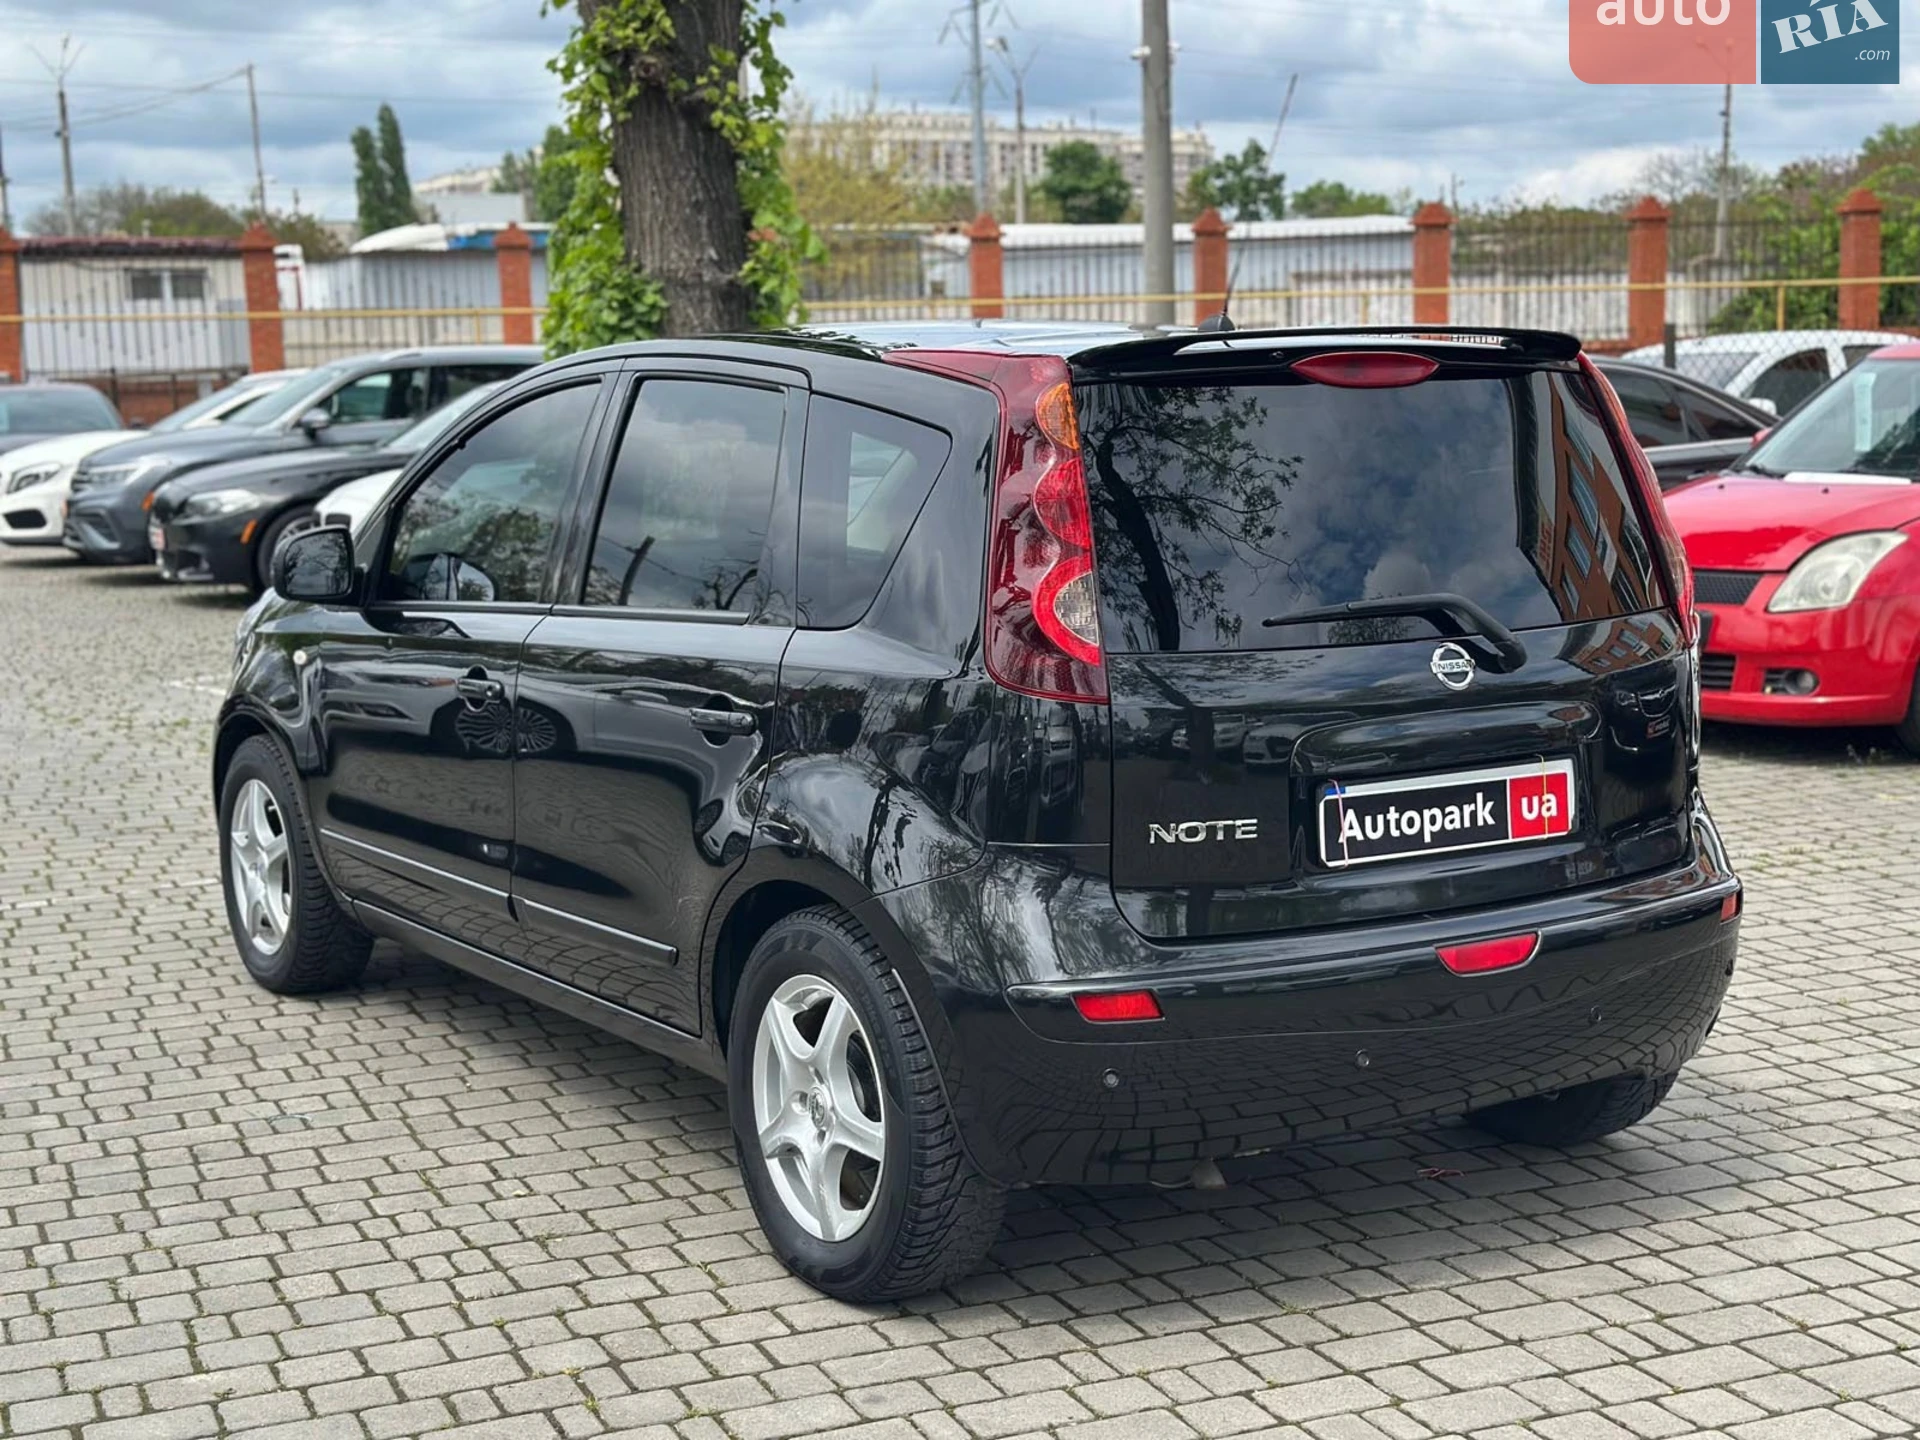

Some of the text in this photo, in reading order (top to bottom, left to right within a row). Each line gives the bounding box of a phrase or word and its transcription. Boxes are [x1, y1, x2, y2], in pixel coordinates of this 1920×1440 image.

[1437, 660, 1474, 671] NISSAN
[1338, 792, 1558, 843] Autopark ua
[1149, 818, 1258, 844] NOTE
